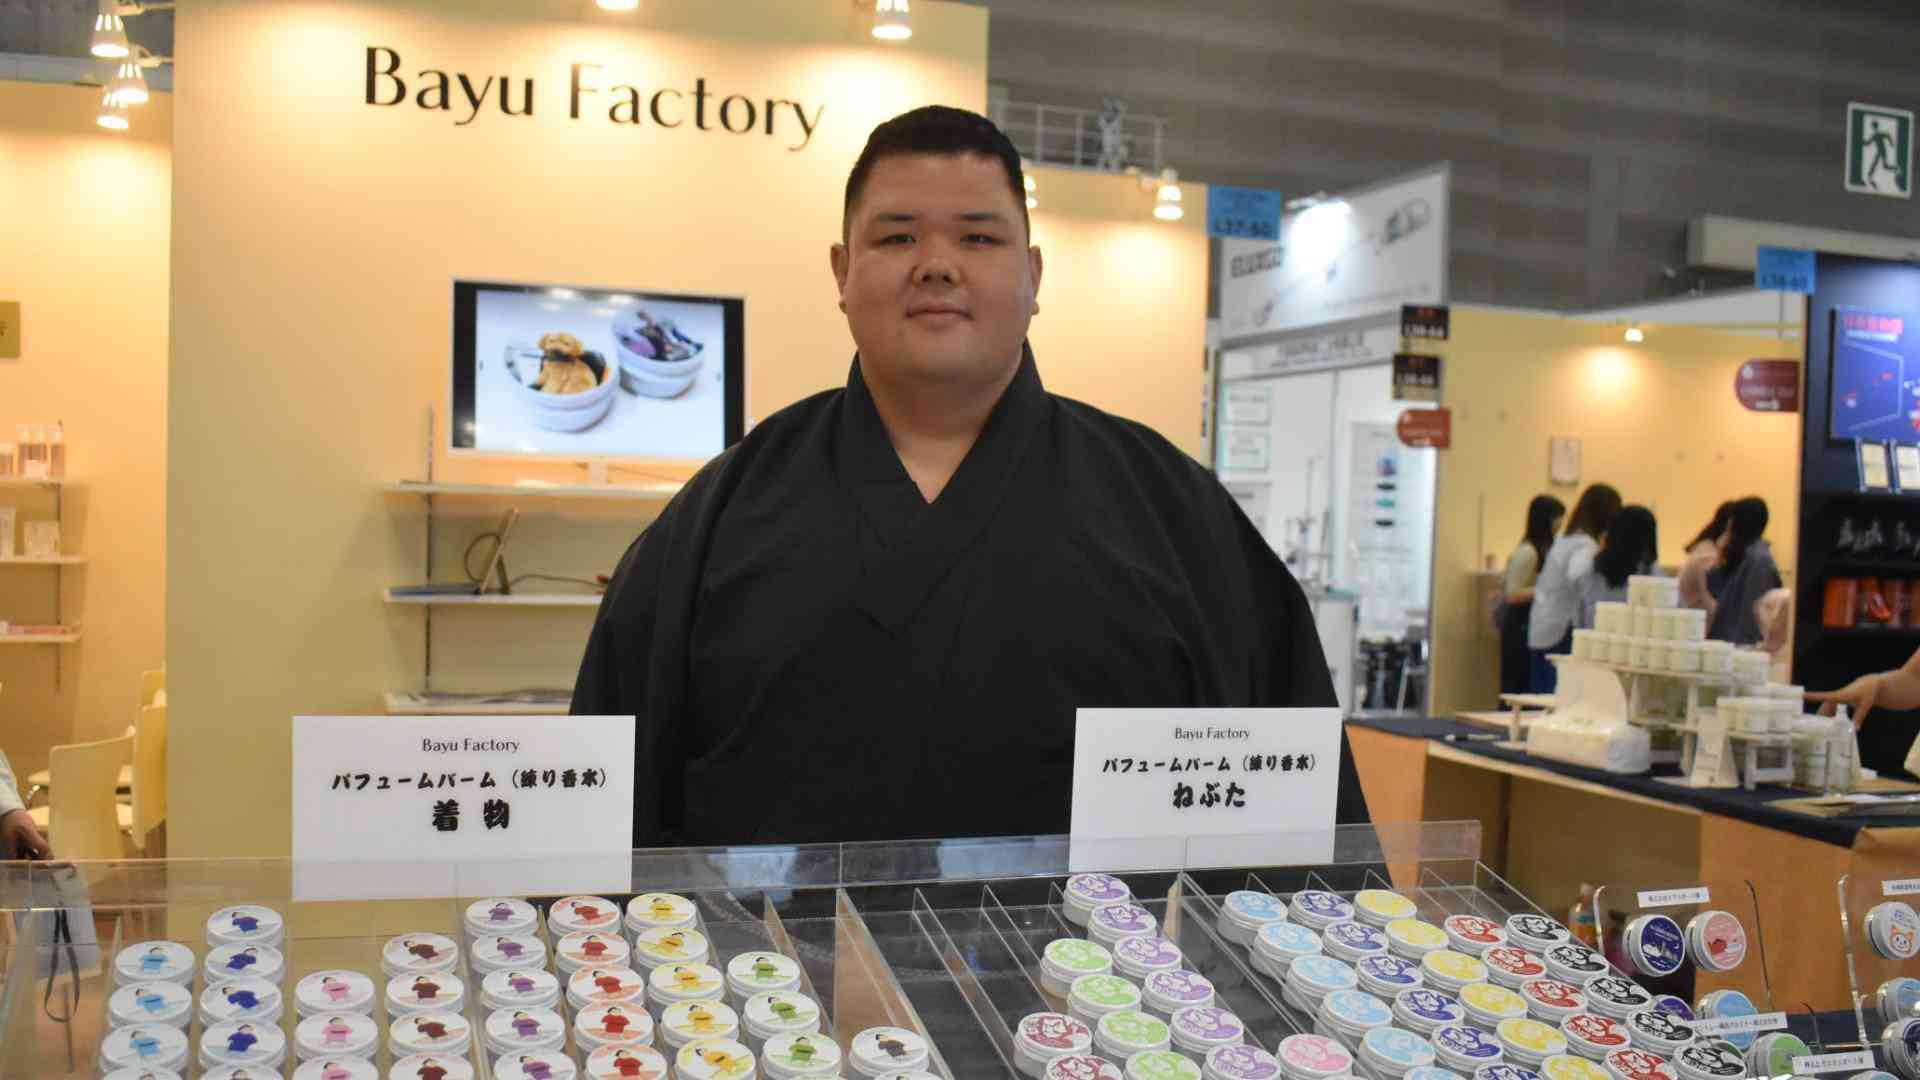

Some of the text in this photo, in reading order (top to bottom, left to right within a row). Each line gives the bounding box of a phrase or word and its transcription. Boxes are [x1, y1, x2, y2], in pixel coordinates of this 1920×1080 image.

[365, 46, 825, 152] Bayu Factory
[1175, 727, 1250, 740] Bayu Factory
[422, 738, 520, 753] Bayu Factory
[1172, 782, 1246, 809] ねぶた
